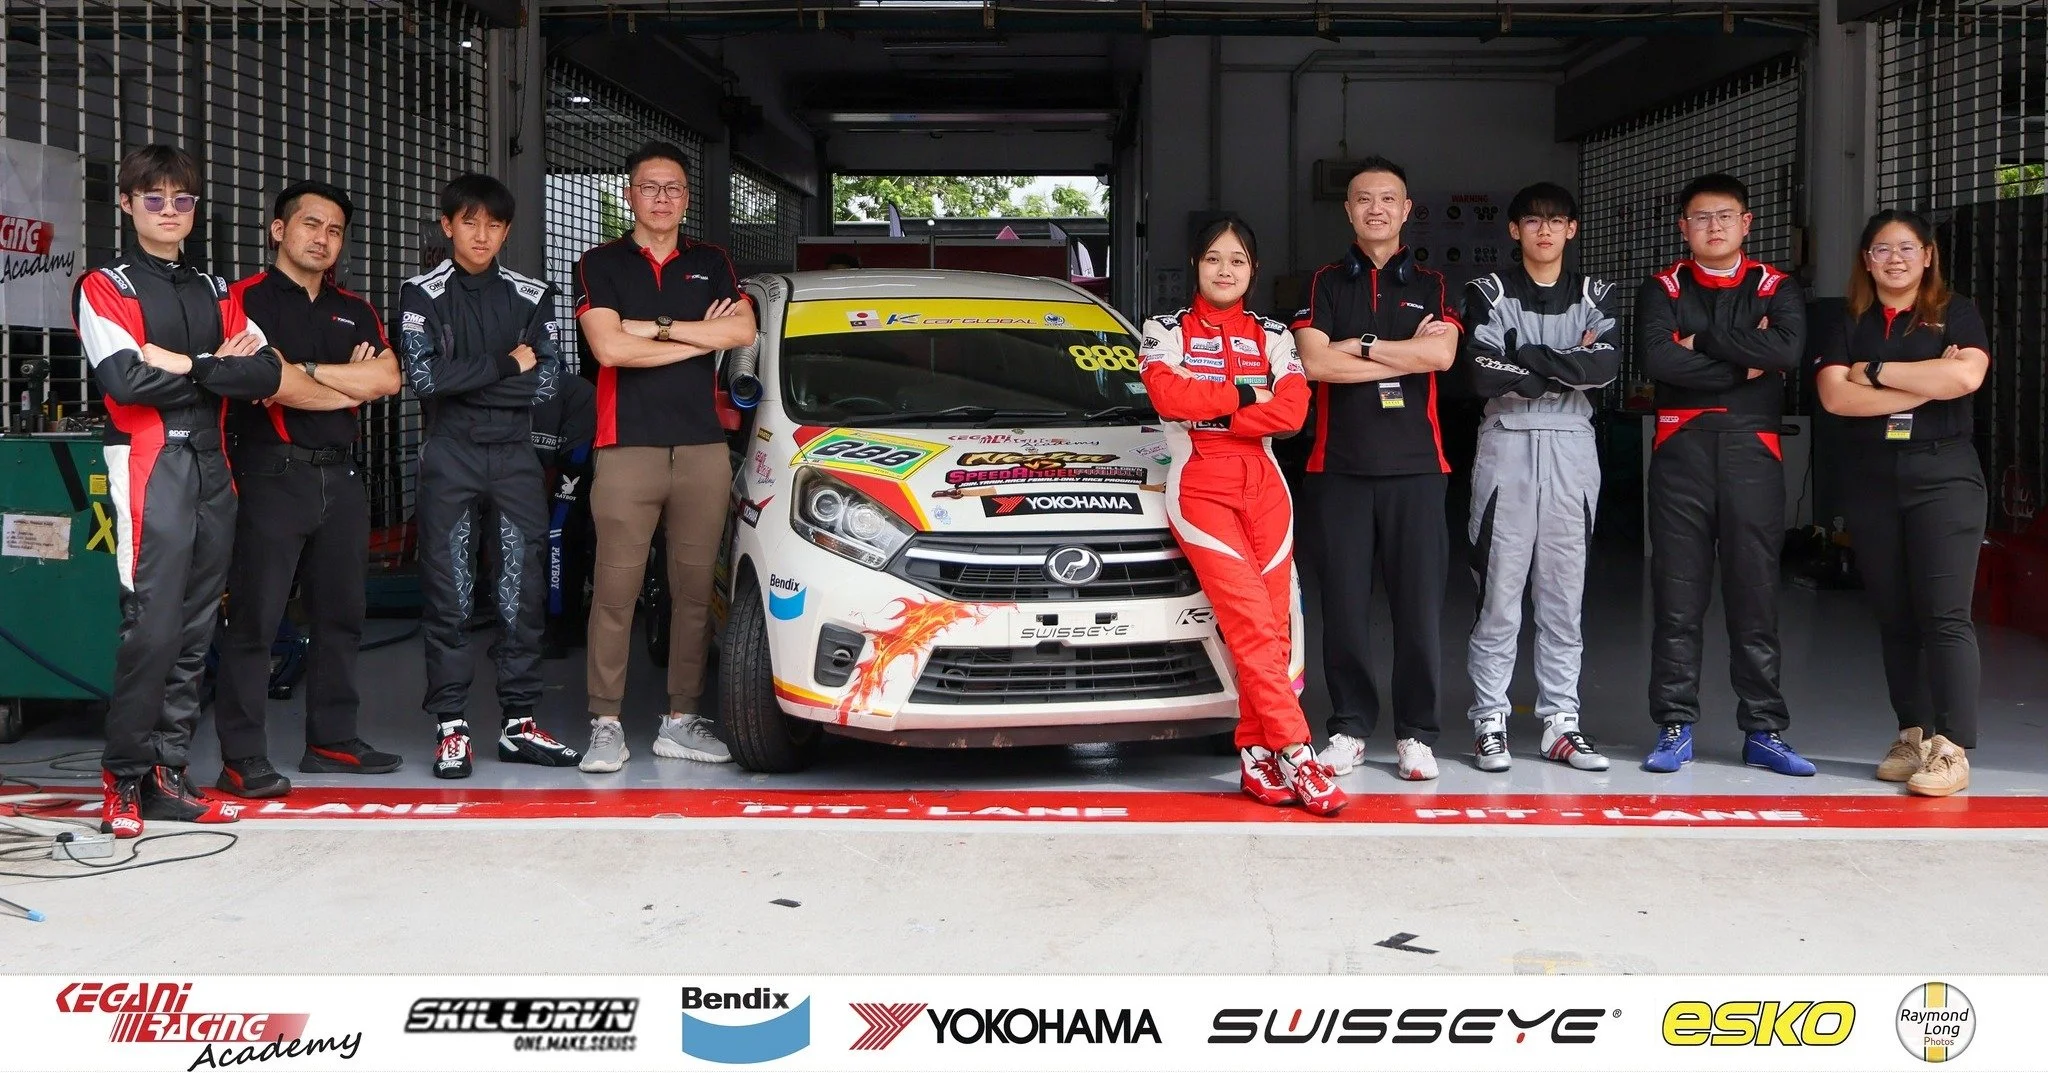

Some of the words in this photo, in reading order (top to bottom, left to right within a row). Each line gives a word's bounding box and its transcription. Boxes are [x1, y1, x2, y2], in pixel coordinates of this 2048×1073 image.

[429, 281, 444, 290] OMP
[521, 286, 539, 296] OMP
[402, 313, 425, 324] OMP
[1143, 338, 1159, 348] OMP
[1068, 345, 1139, 371] 888
[1026, 496, 1133, 510] YOKOHAMA
[551, 546, 560, 589] PLAYBOY
[770, 573, 800, 592] Bendix
[1020, 625, 1130, 639] SWISSEYE
[260, 801, 465, 814] LANE
[742, 804, 869, 815] PIT
[940, 806, 1129, 817] LANE
[1415, 808, 1538, 819] PIT
[1603, 808, 1812, 821] LANE
